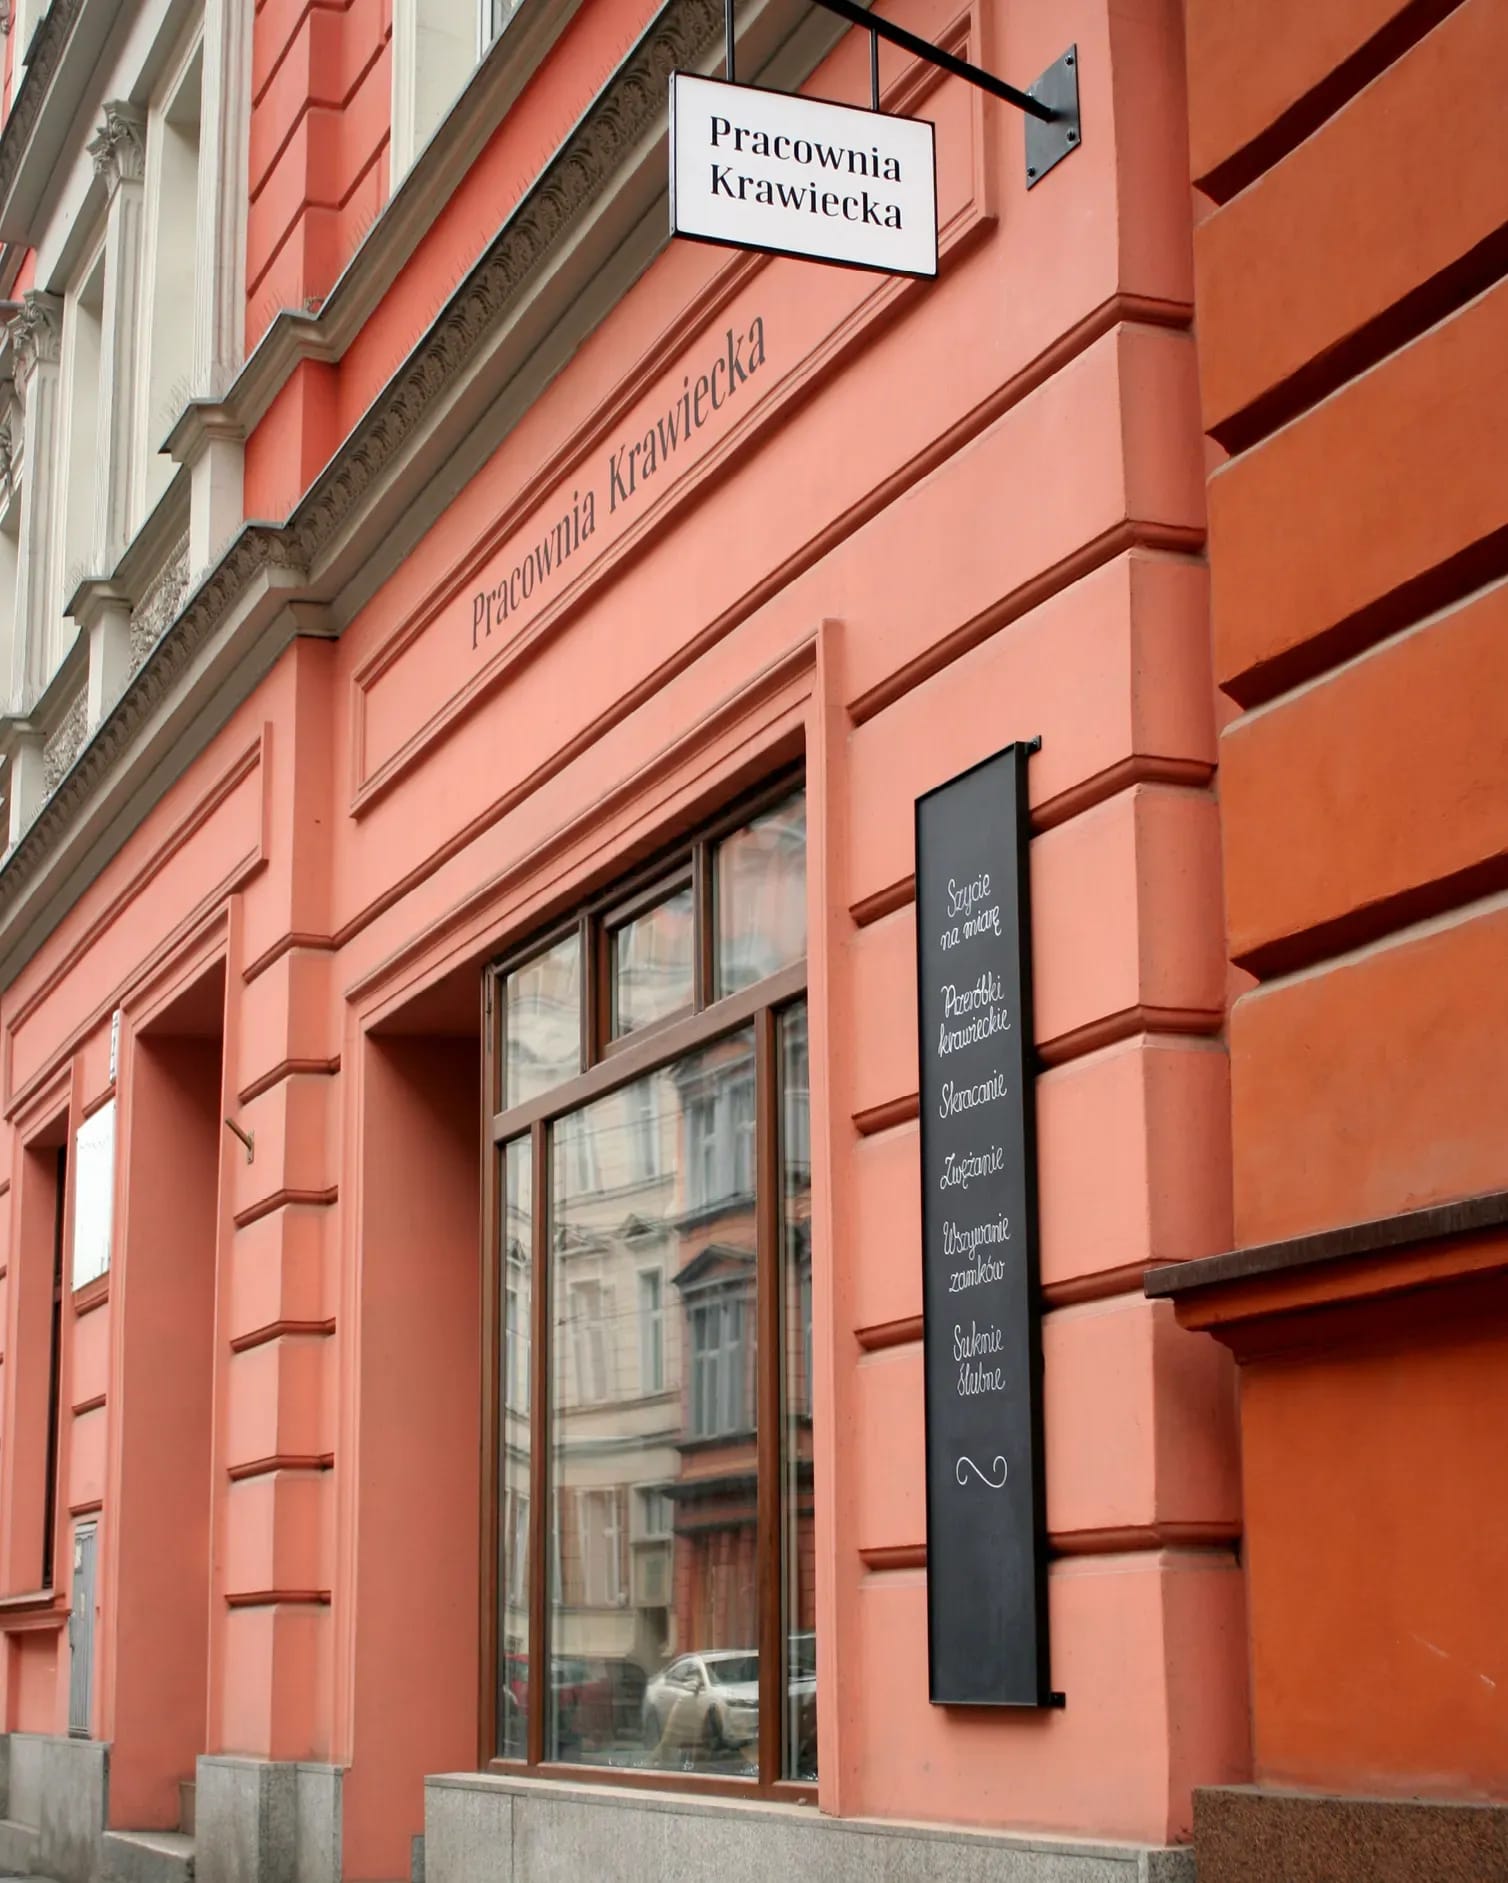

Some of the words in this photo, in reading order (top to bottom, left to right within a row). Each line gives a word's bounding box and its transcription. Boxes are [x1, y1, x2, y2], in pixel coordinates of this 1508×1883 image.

[710, 116, 901, 182] Pracownia
[710, 164, 902, 229] Krawiecka
[472, 490, 596, 650] Pracownia
[609, 316, 766, 515] Krawiecka
[947, 874, 991, 917] Szycie
[940, 927, 960, 950] na
[962, 905, 1001, 936] miarę
[938, 1006, 1011, 1057] krawieckie
[939, 1070, 1007, 1118] Skracanie
[940, 1145, 1004, 1189] Zwężanie
[943, 1212, 1011, 1261] Wszywanie
[949, 1254, 1005, 1293] zamków
[953, 1320, 1004, 1361] Suknie
